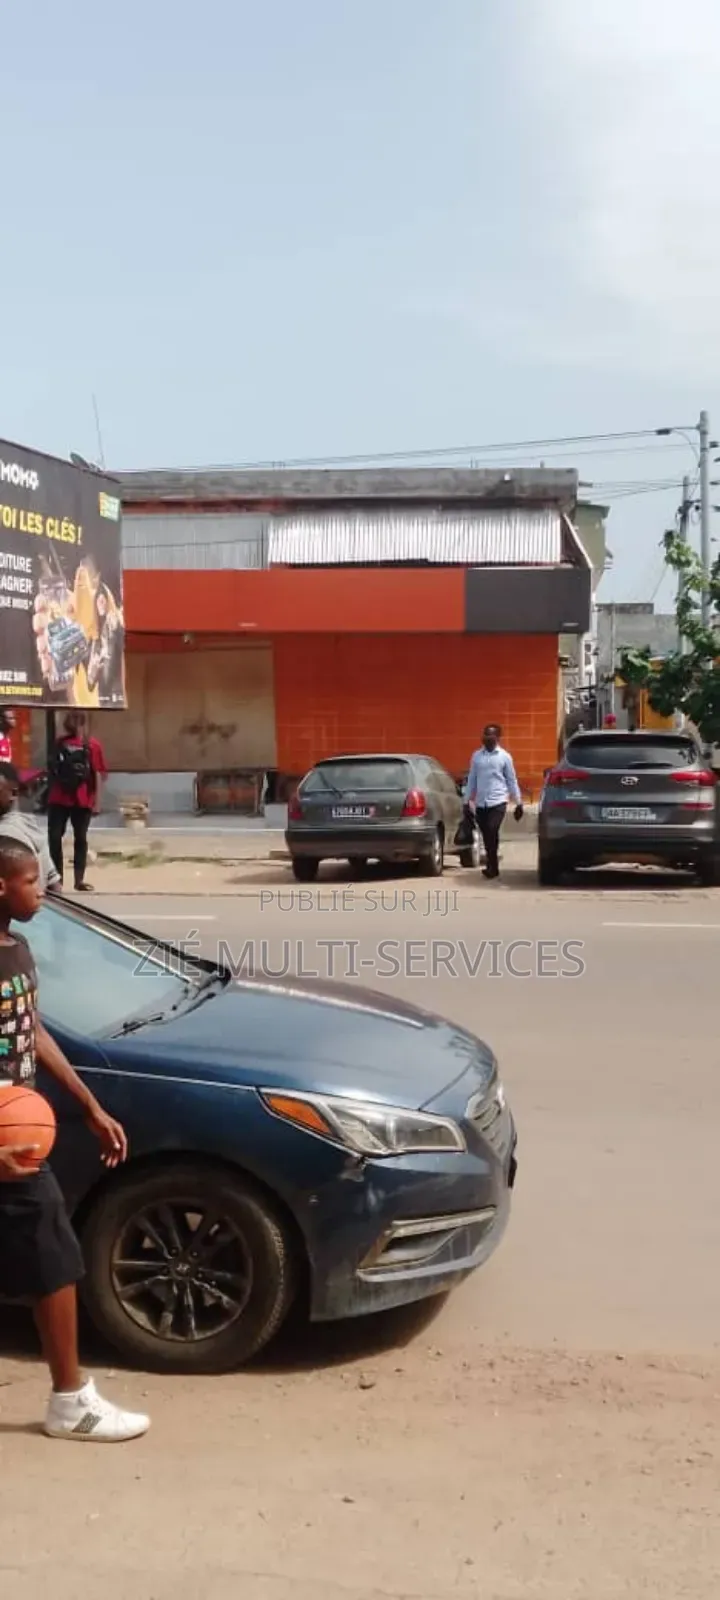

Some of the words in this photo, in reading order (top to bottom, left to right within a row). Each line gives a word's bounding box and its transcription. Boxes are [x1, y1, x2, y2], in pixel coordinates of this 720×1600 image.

[19, 510, 44, 535] LES
[45, 517, 76, 543] CLÉS
[0, 575, 33, 594] AGNER
